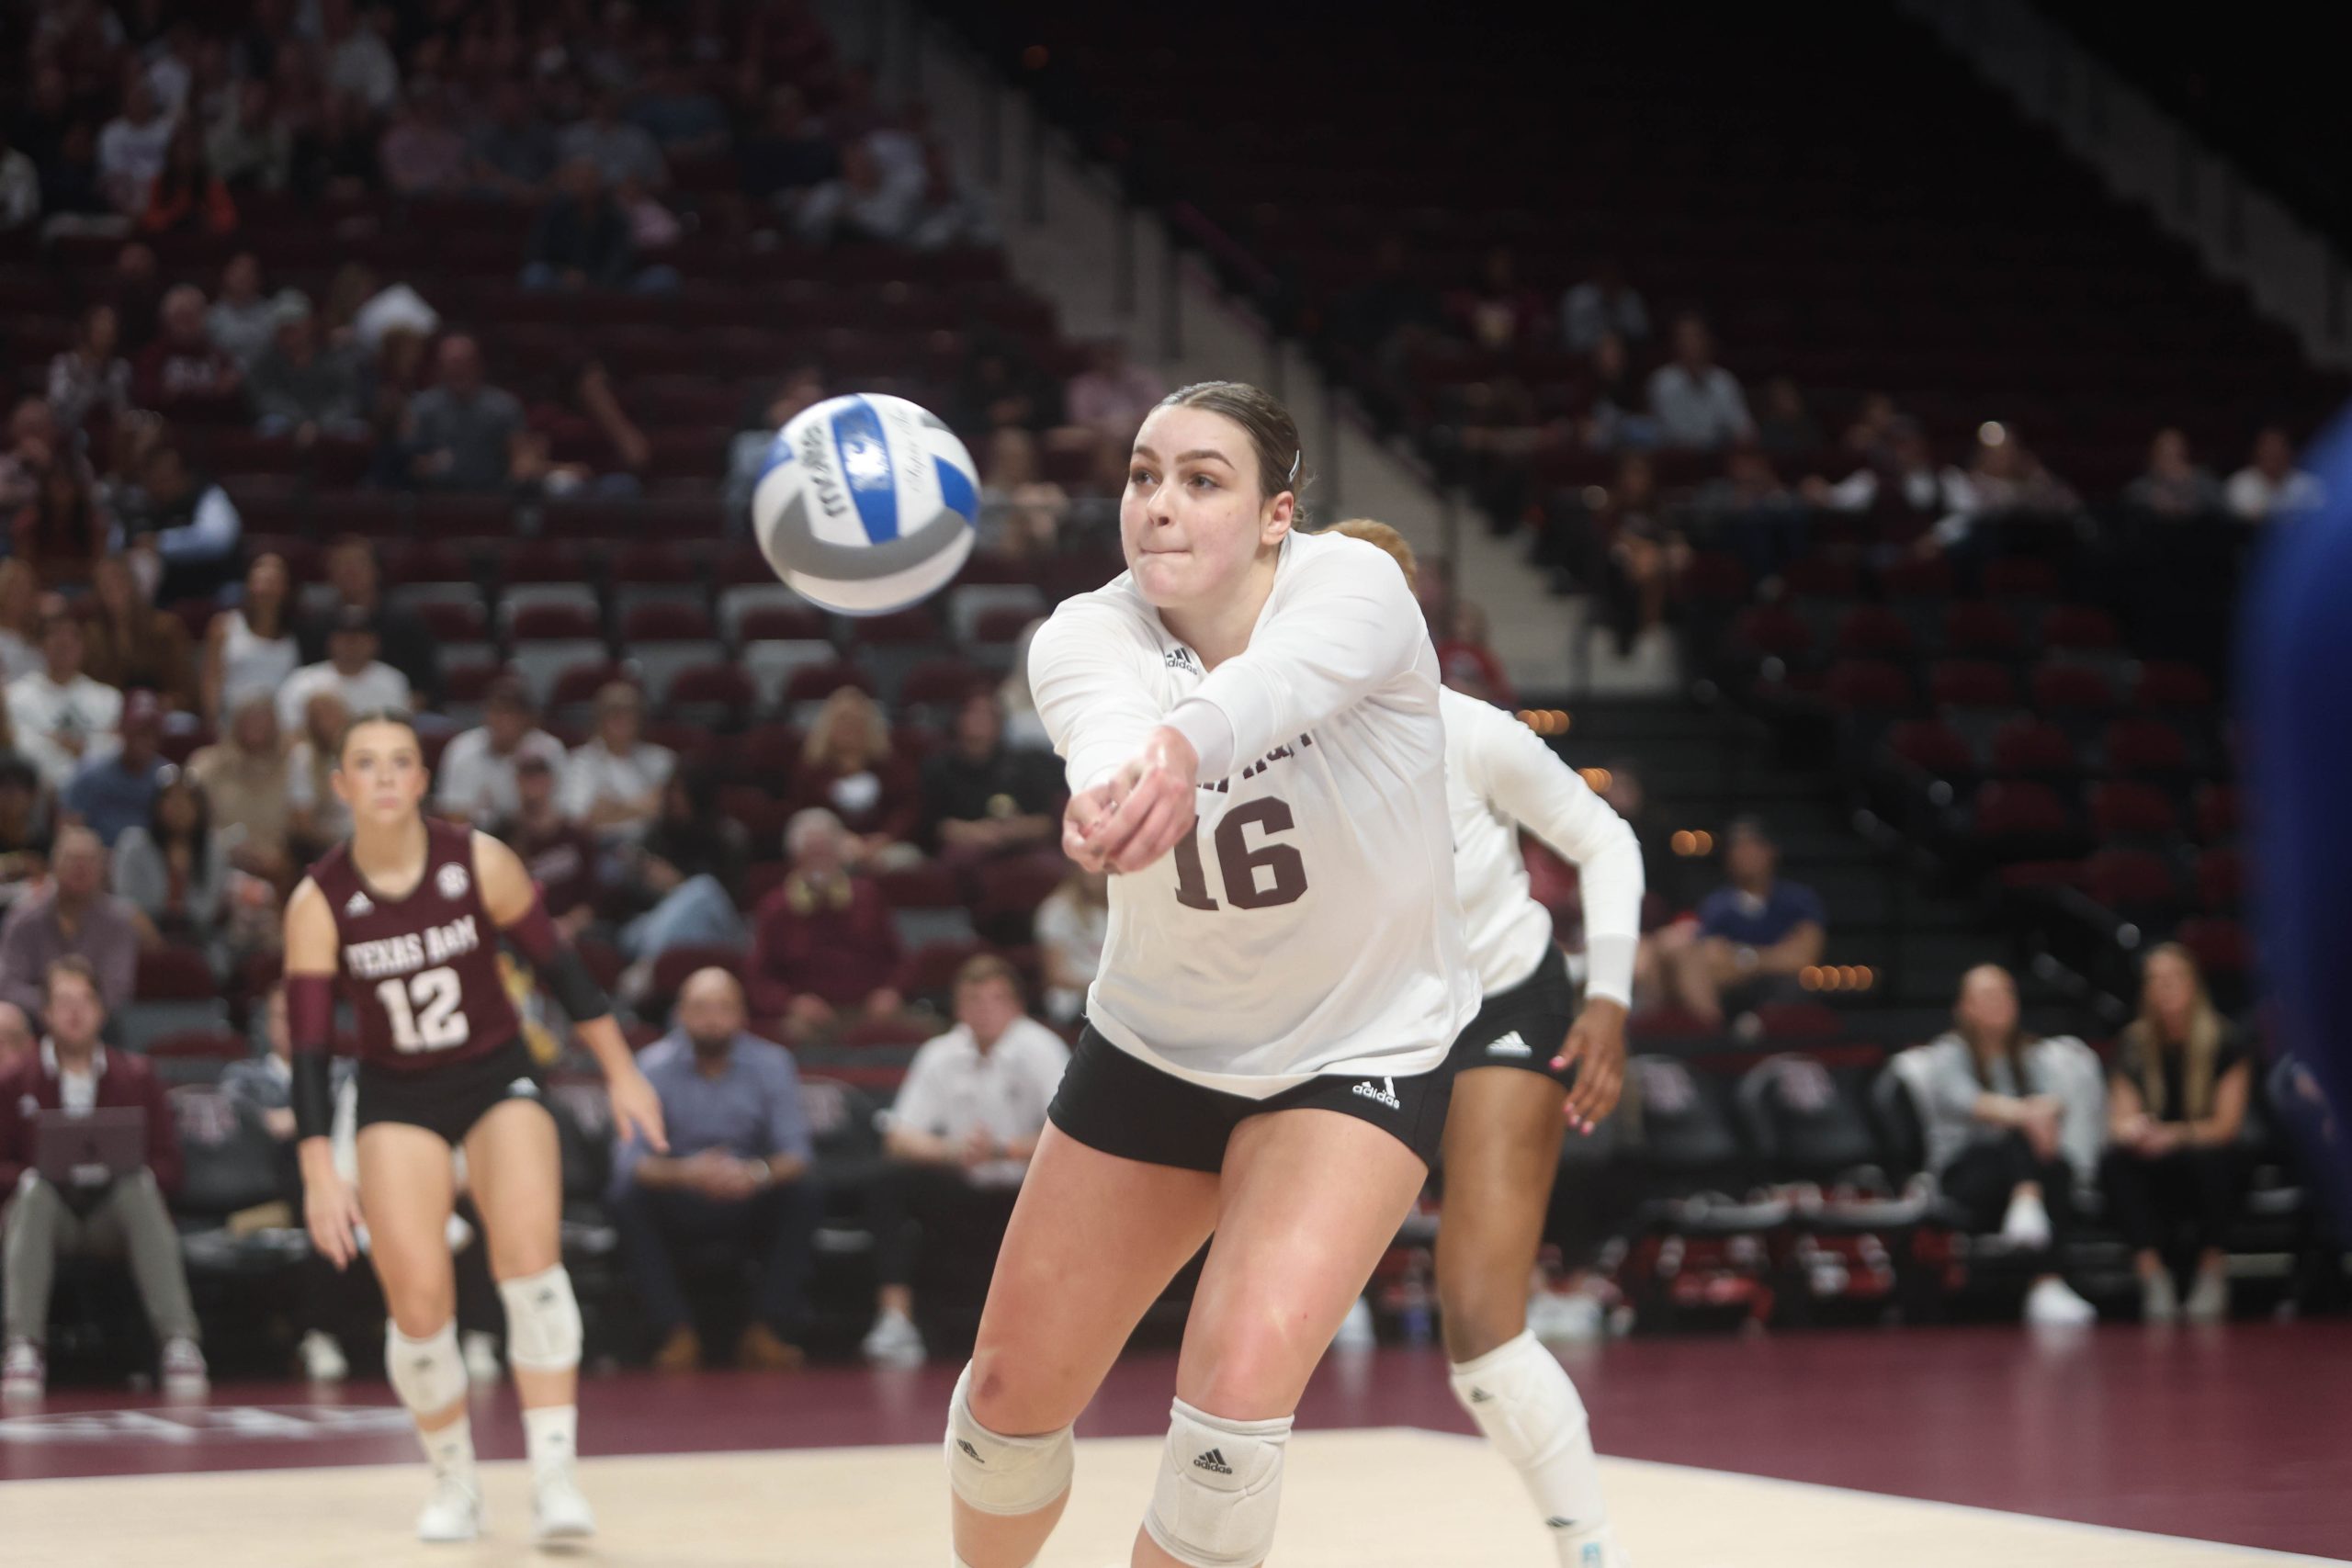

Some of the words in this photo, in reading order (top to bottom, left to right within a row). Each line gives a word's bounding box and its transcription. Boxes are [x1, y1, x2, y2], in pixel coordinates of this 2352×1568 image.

[798, 420, 848, 518] molte
[1166, 657, 1198, 675] didas
[1174, 795, 1308, 912] 16
[345, 932, 425, 980] TEXAS
[376, 965, 469, 1055] 12
[1352, 1085, 1400, 1110] adidas
[1193, 1459, 1232, 1475] adidas
